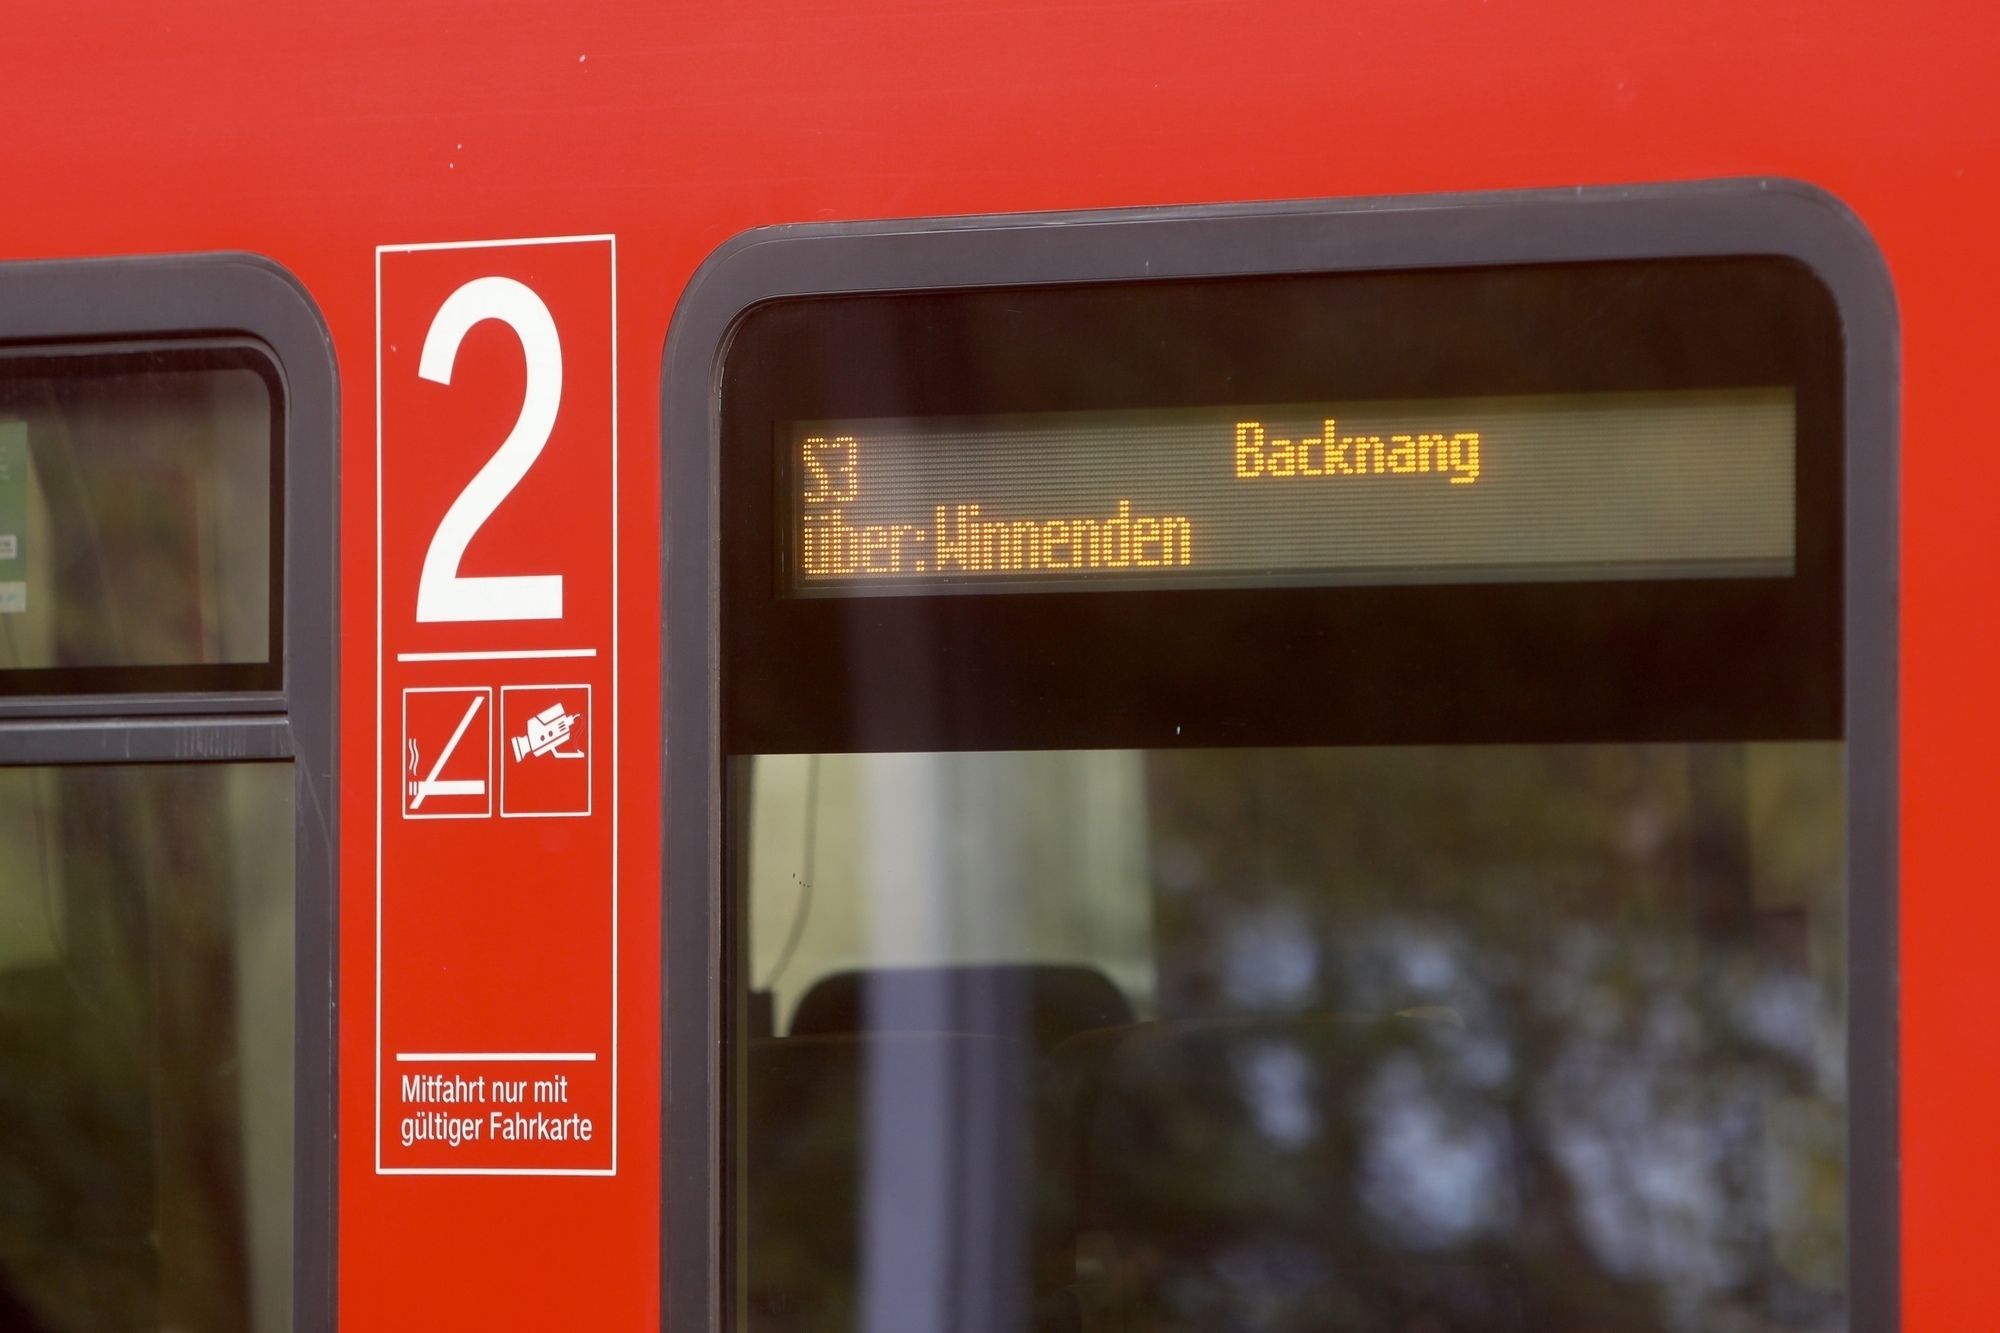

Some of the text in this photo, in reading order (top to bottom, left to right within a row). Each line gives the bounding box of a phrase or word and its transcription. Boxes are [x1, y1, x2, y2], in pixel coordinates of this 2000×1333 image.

[415, 275, 564, 624] 2
[802, 418, 1481, 503] S3 Backnang
[935, 499, 1193, 571] Winnenden
[401, 1074, 568, 1104] Mitfahrt nur mit
[401, 1111, 593, 1148] gültiger Fahrkarte
